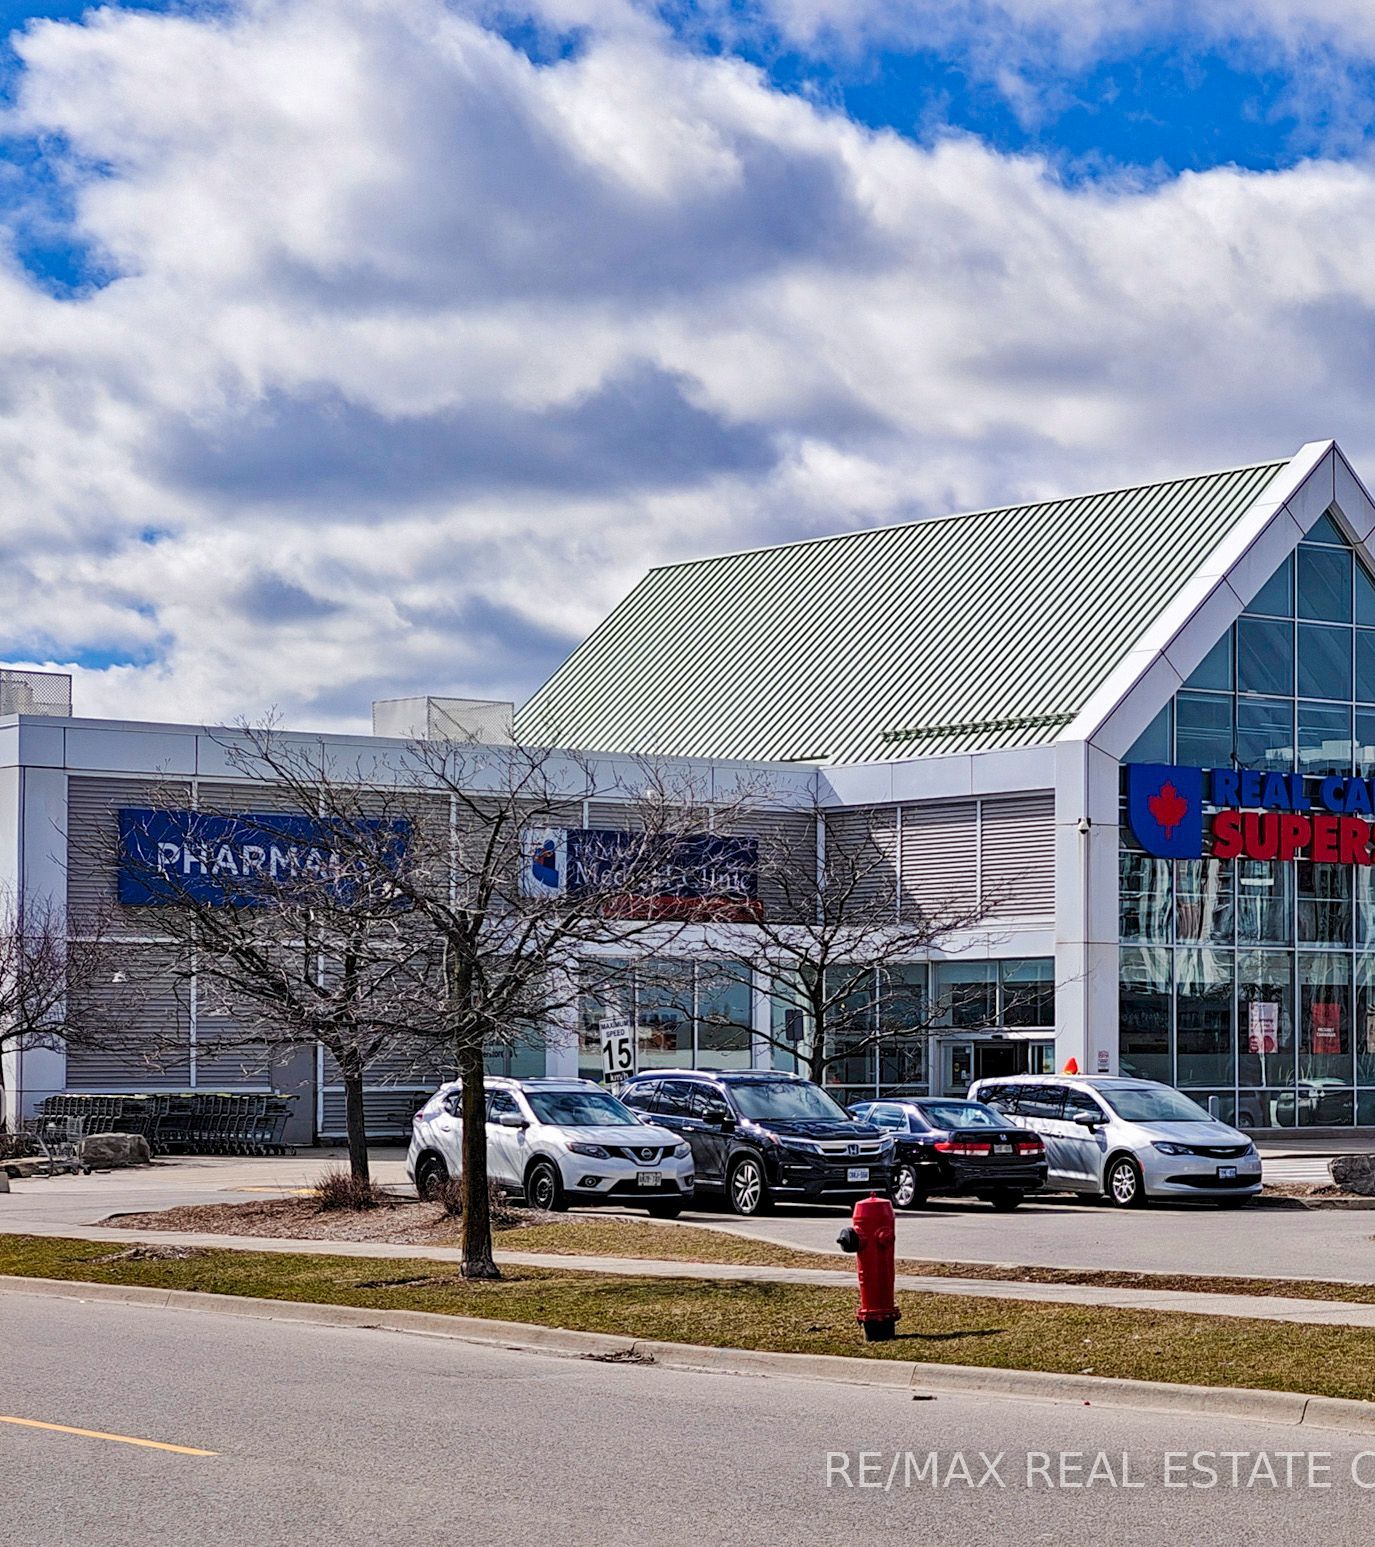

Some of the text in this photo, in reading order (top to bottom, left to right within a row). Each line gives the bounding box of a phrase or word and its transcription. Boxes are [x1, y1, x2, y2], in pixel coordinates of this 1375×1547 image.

[1212, 768, 1309, 809] REAL
[156, 841, 372, 878] PHARMA
[601, 1020, 629, 1029] MAXIMUM
[606, 1029, 625, 1037] SPEED
[603, 1038, 631, 1070] 15
